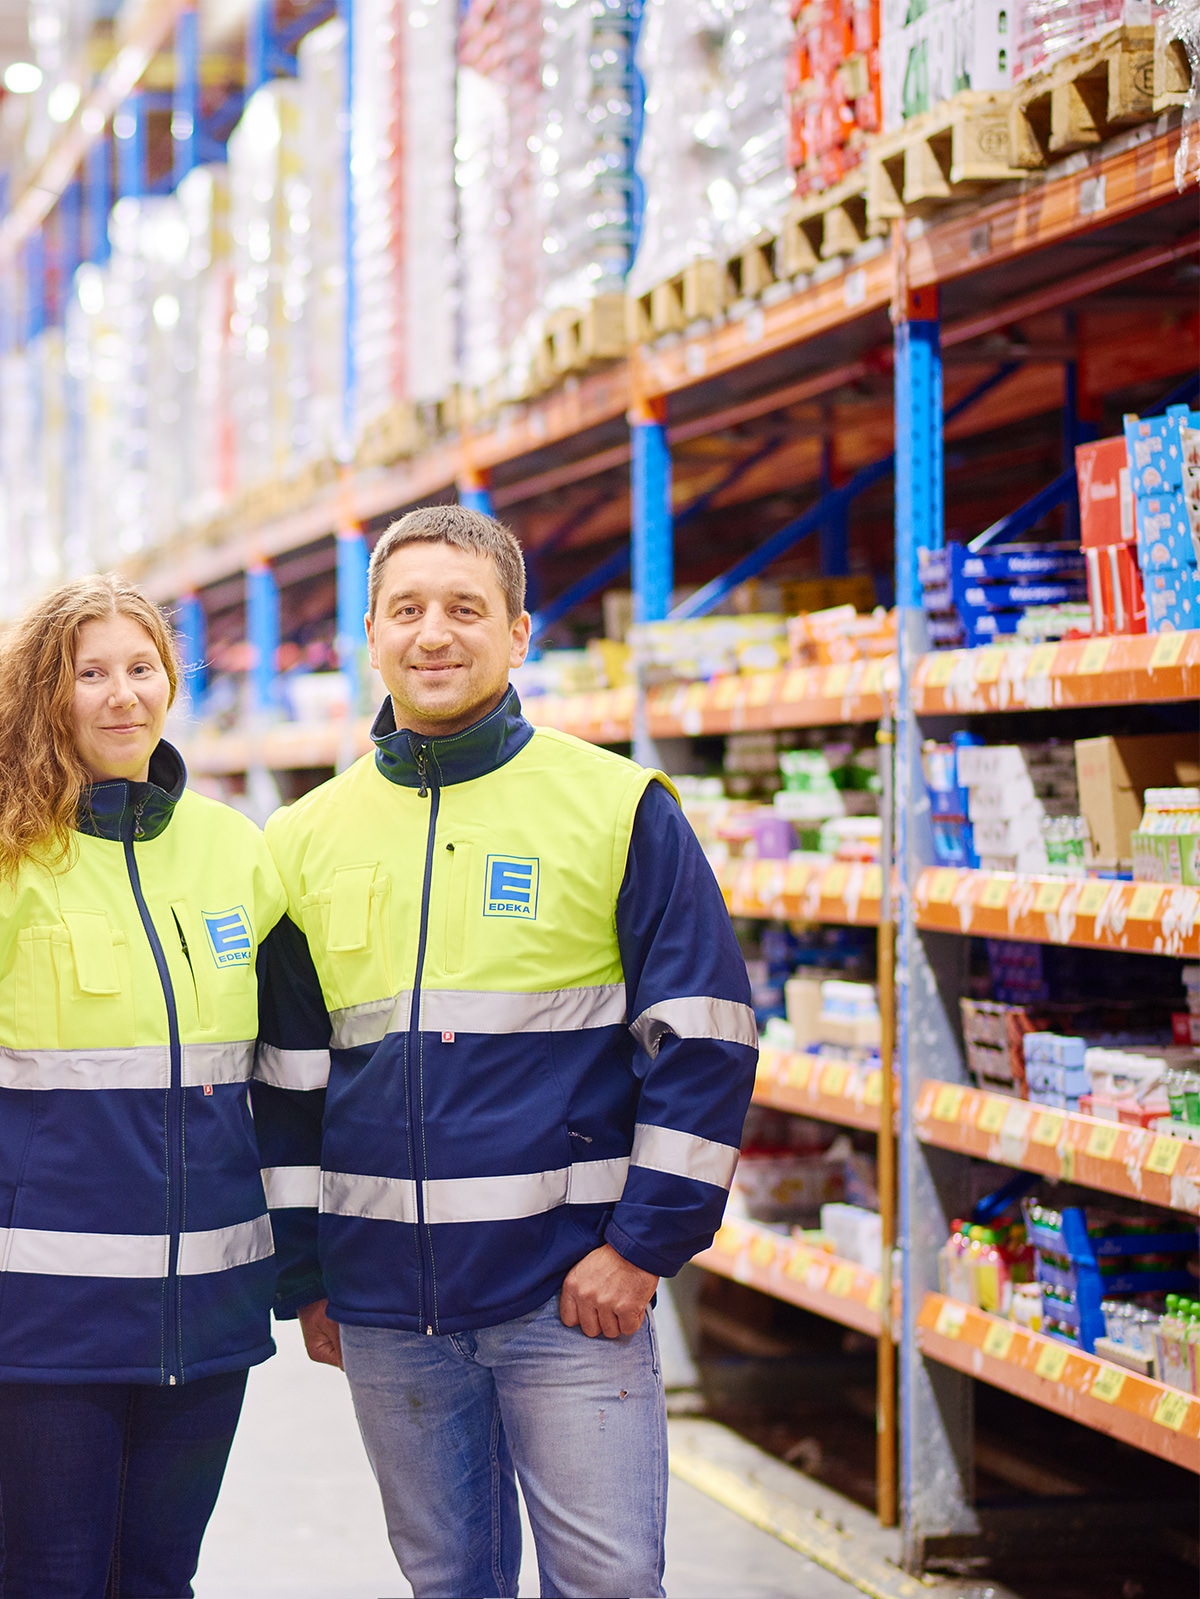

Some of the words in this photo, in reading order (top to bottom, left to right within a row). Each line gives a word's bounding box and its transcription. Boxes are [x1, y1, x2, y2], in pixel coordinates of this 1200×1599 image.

[490, 861, 532, 903] E
[489, 903, 530, 913] EDEKA
[205, 913, 251, 953] E
